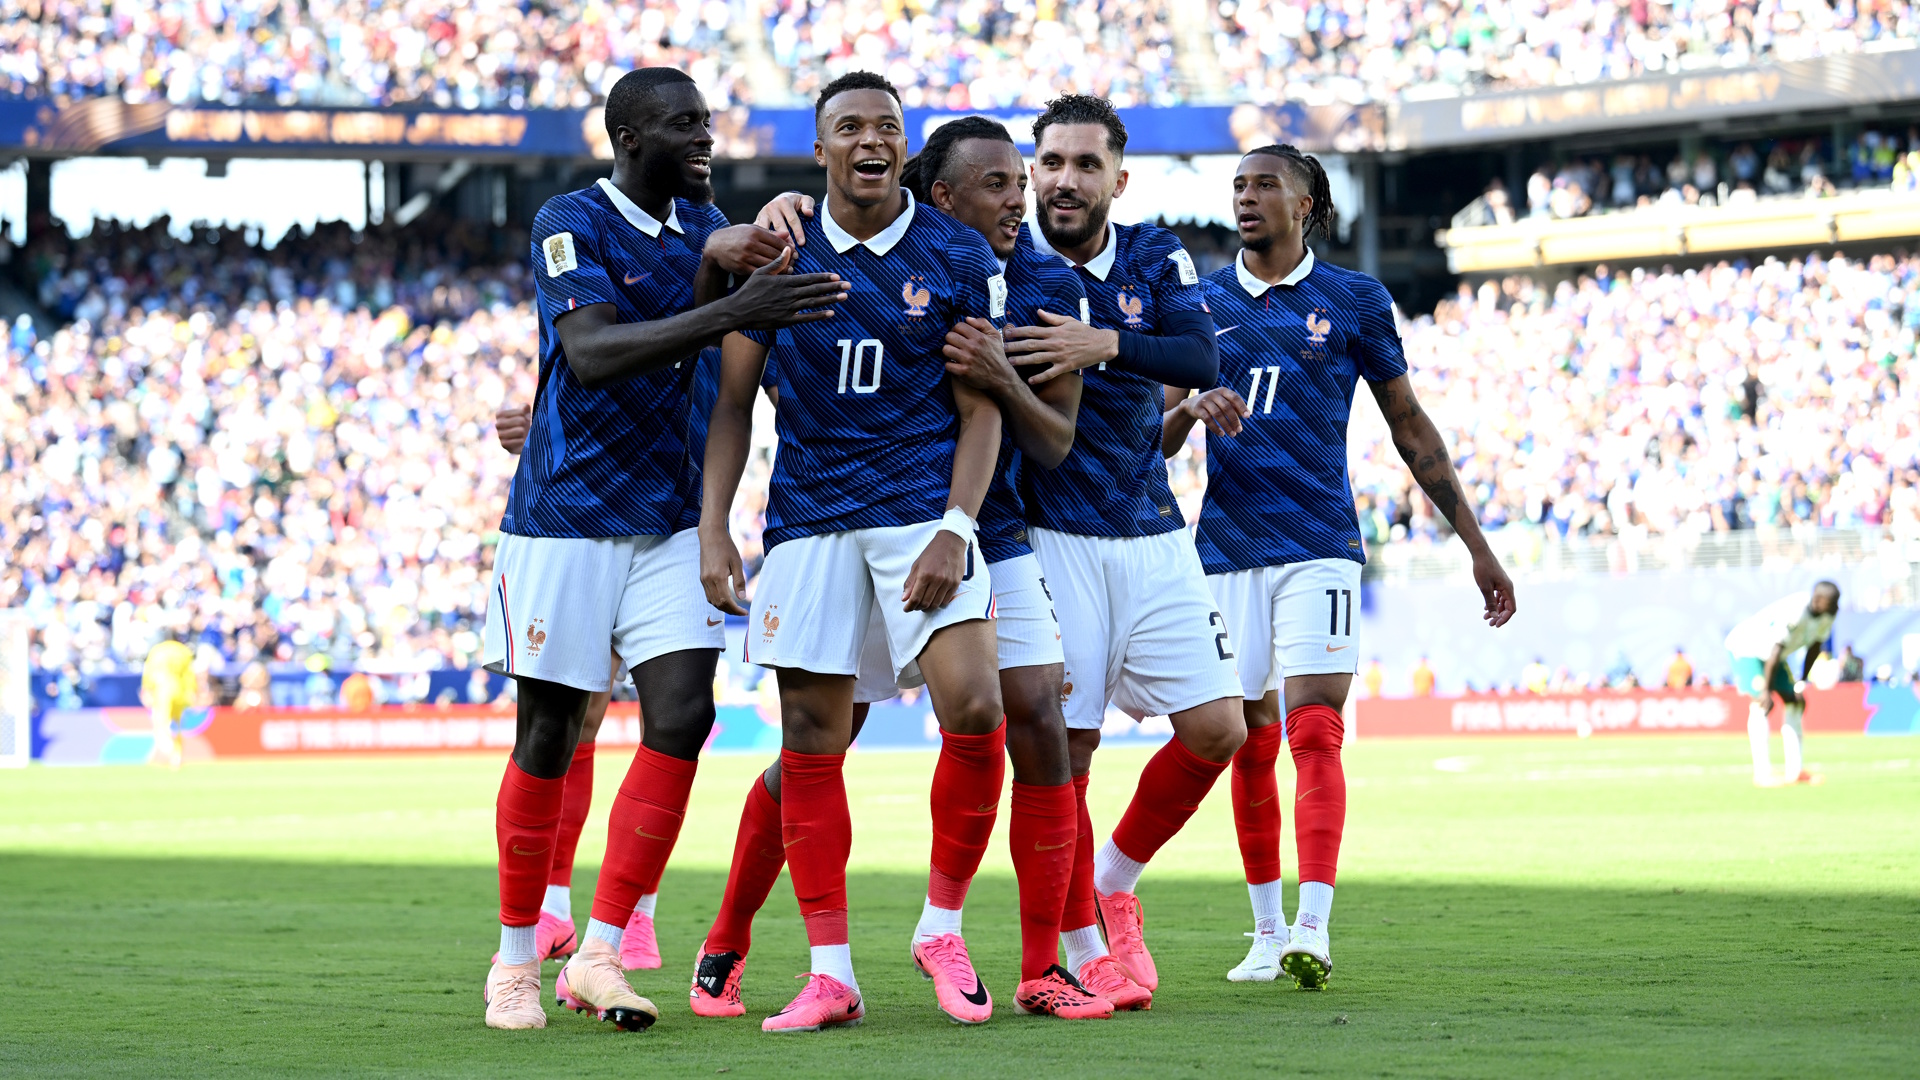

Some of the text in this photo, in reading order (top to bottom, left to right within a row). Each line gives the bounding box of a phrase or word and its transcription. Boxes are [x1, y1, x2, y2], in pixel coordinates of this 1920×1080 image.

[331, 111, 406, 144] NEW
[836, 338, 885, 394] 10
[1246, 365, 1281, 415] 11
[1325, 588, 1352, 636] 11
[1452, 700, 1502, 731] FIFA
[1504, 700, 1587, 731] WORLD
[1590, 698, 1637, 729] CUP
